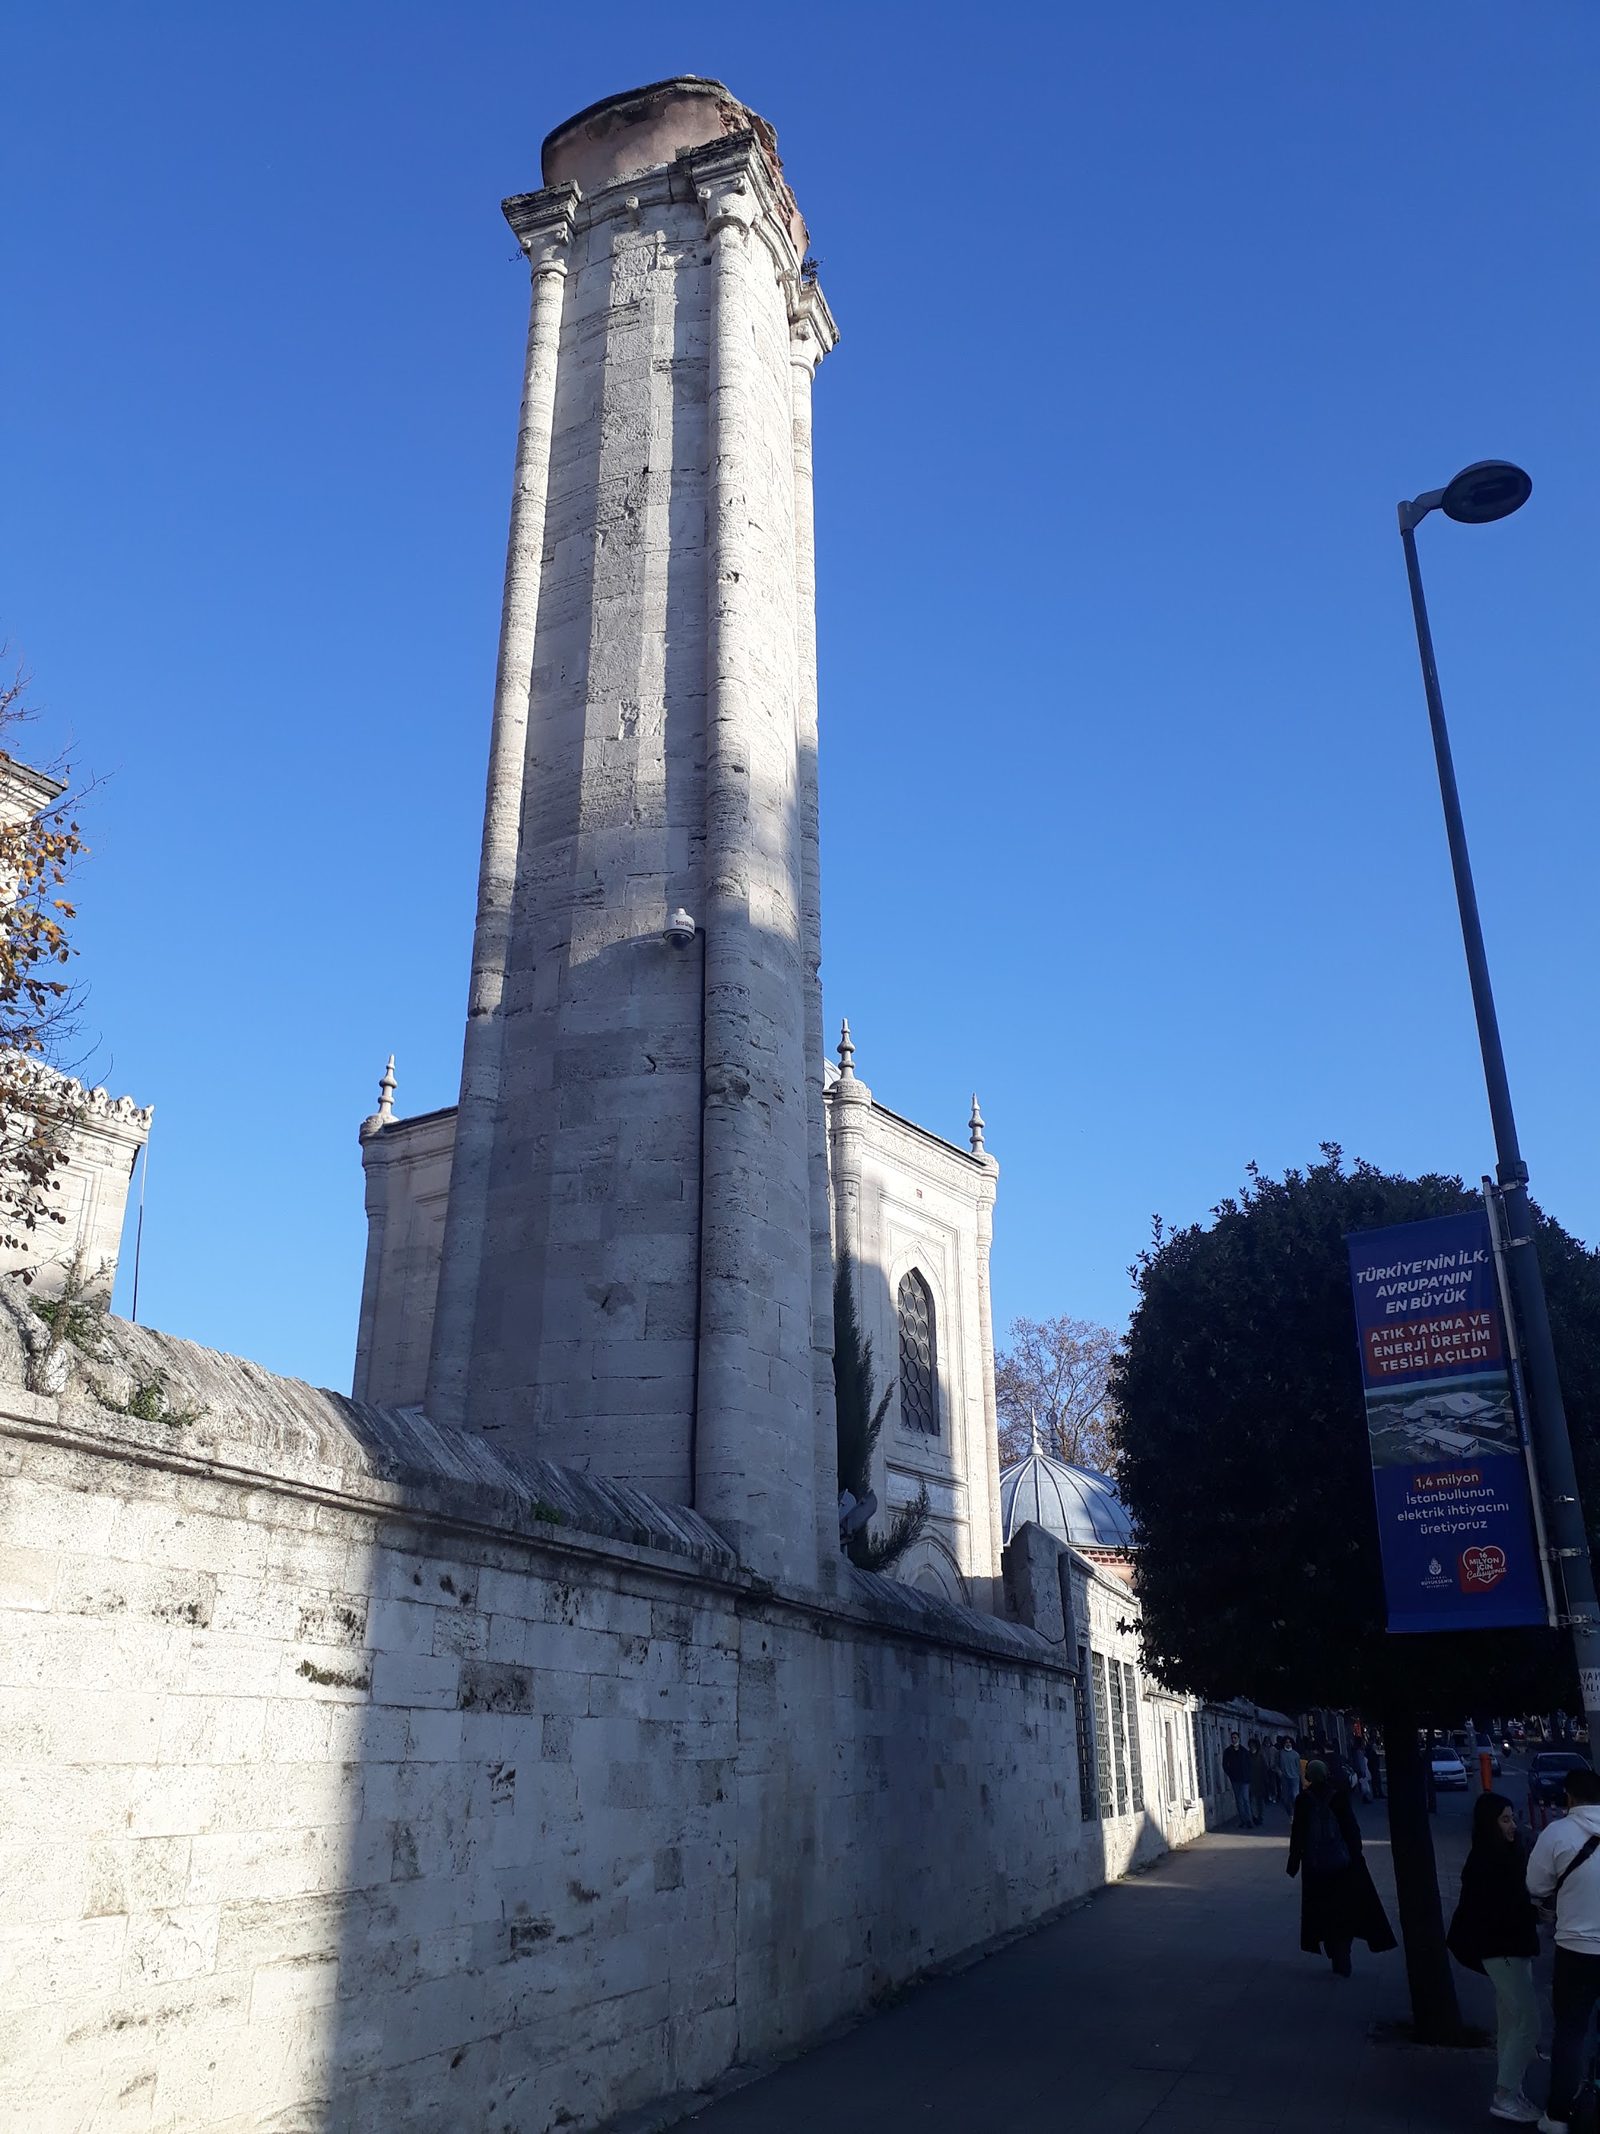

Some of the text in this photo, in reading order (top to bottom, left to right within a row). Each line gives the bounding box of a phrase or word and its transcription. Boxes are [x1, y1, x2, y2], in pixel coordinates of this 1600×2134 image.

[1356, 1250, 1489, 1284] TÜRKİYE'NİN İLK,
[1376, 1270, 1473, 1298] AVRUPA'NIN
[1386, 1288, 1466, 1314] EN BÜYÜK
[1370, 1314, 1491, 1342] ATIK YAKMA VE
[1374, 1329, 1490, 1357] ENERJİ ÜRETİM
[1381, 1346, 1487, 1371] TESİSİ AÇILDI
[1416, 1474, 1479, 1489] 1,4 milyon
[1406, 1488, 1494, 1505] İstanbullunun
[1397, 1503, 1509, 1521] elektrik ihtiyacını
[1420, 1520, 1488, 1534] üretiyoruz
